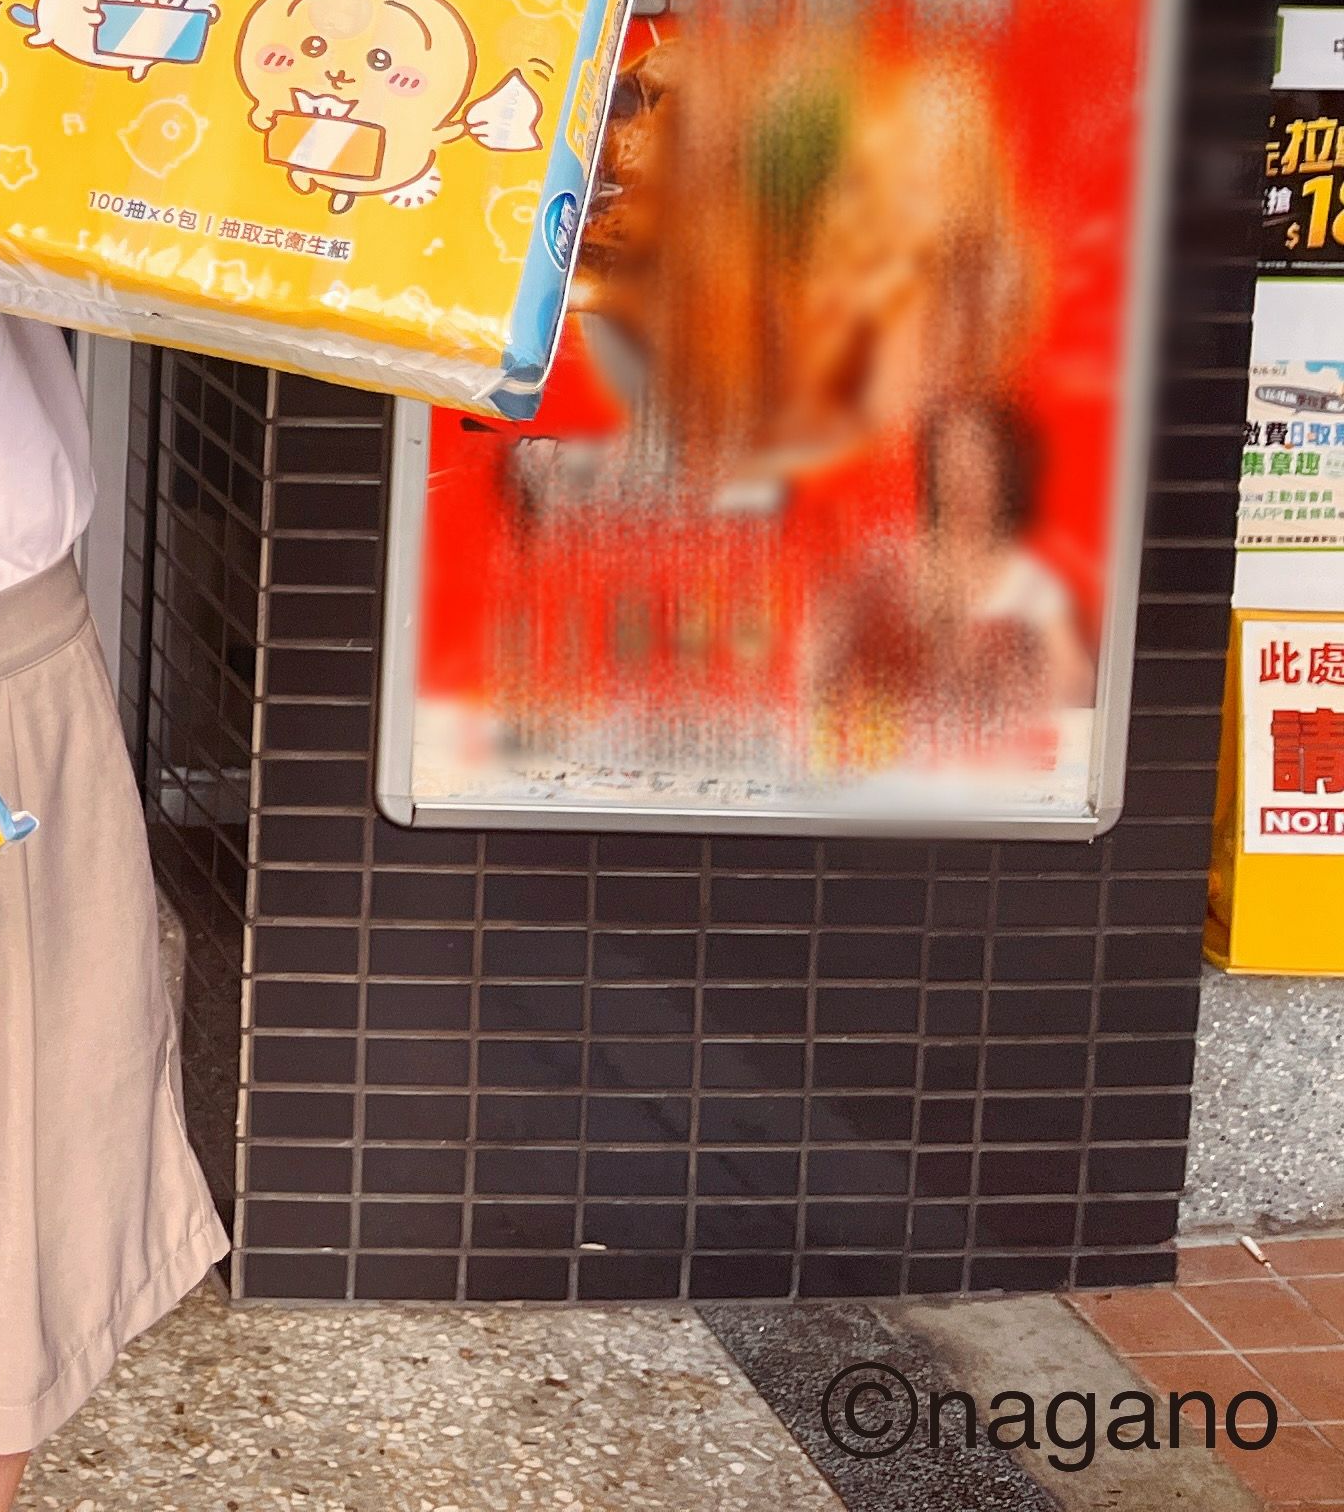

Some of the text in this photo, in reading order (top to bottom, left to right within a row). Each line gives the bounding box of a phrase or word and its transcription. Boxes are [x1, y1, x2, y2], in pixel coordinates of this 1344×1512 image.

[219, 216, 353, 263] 抽取式衛生紙
